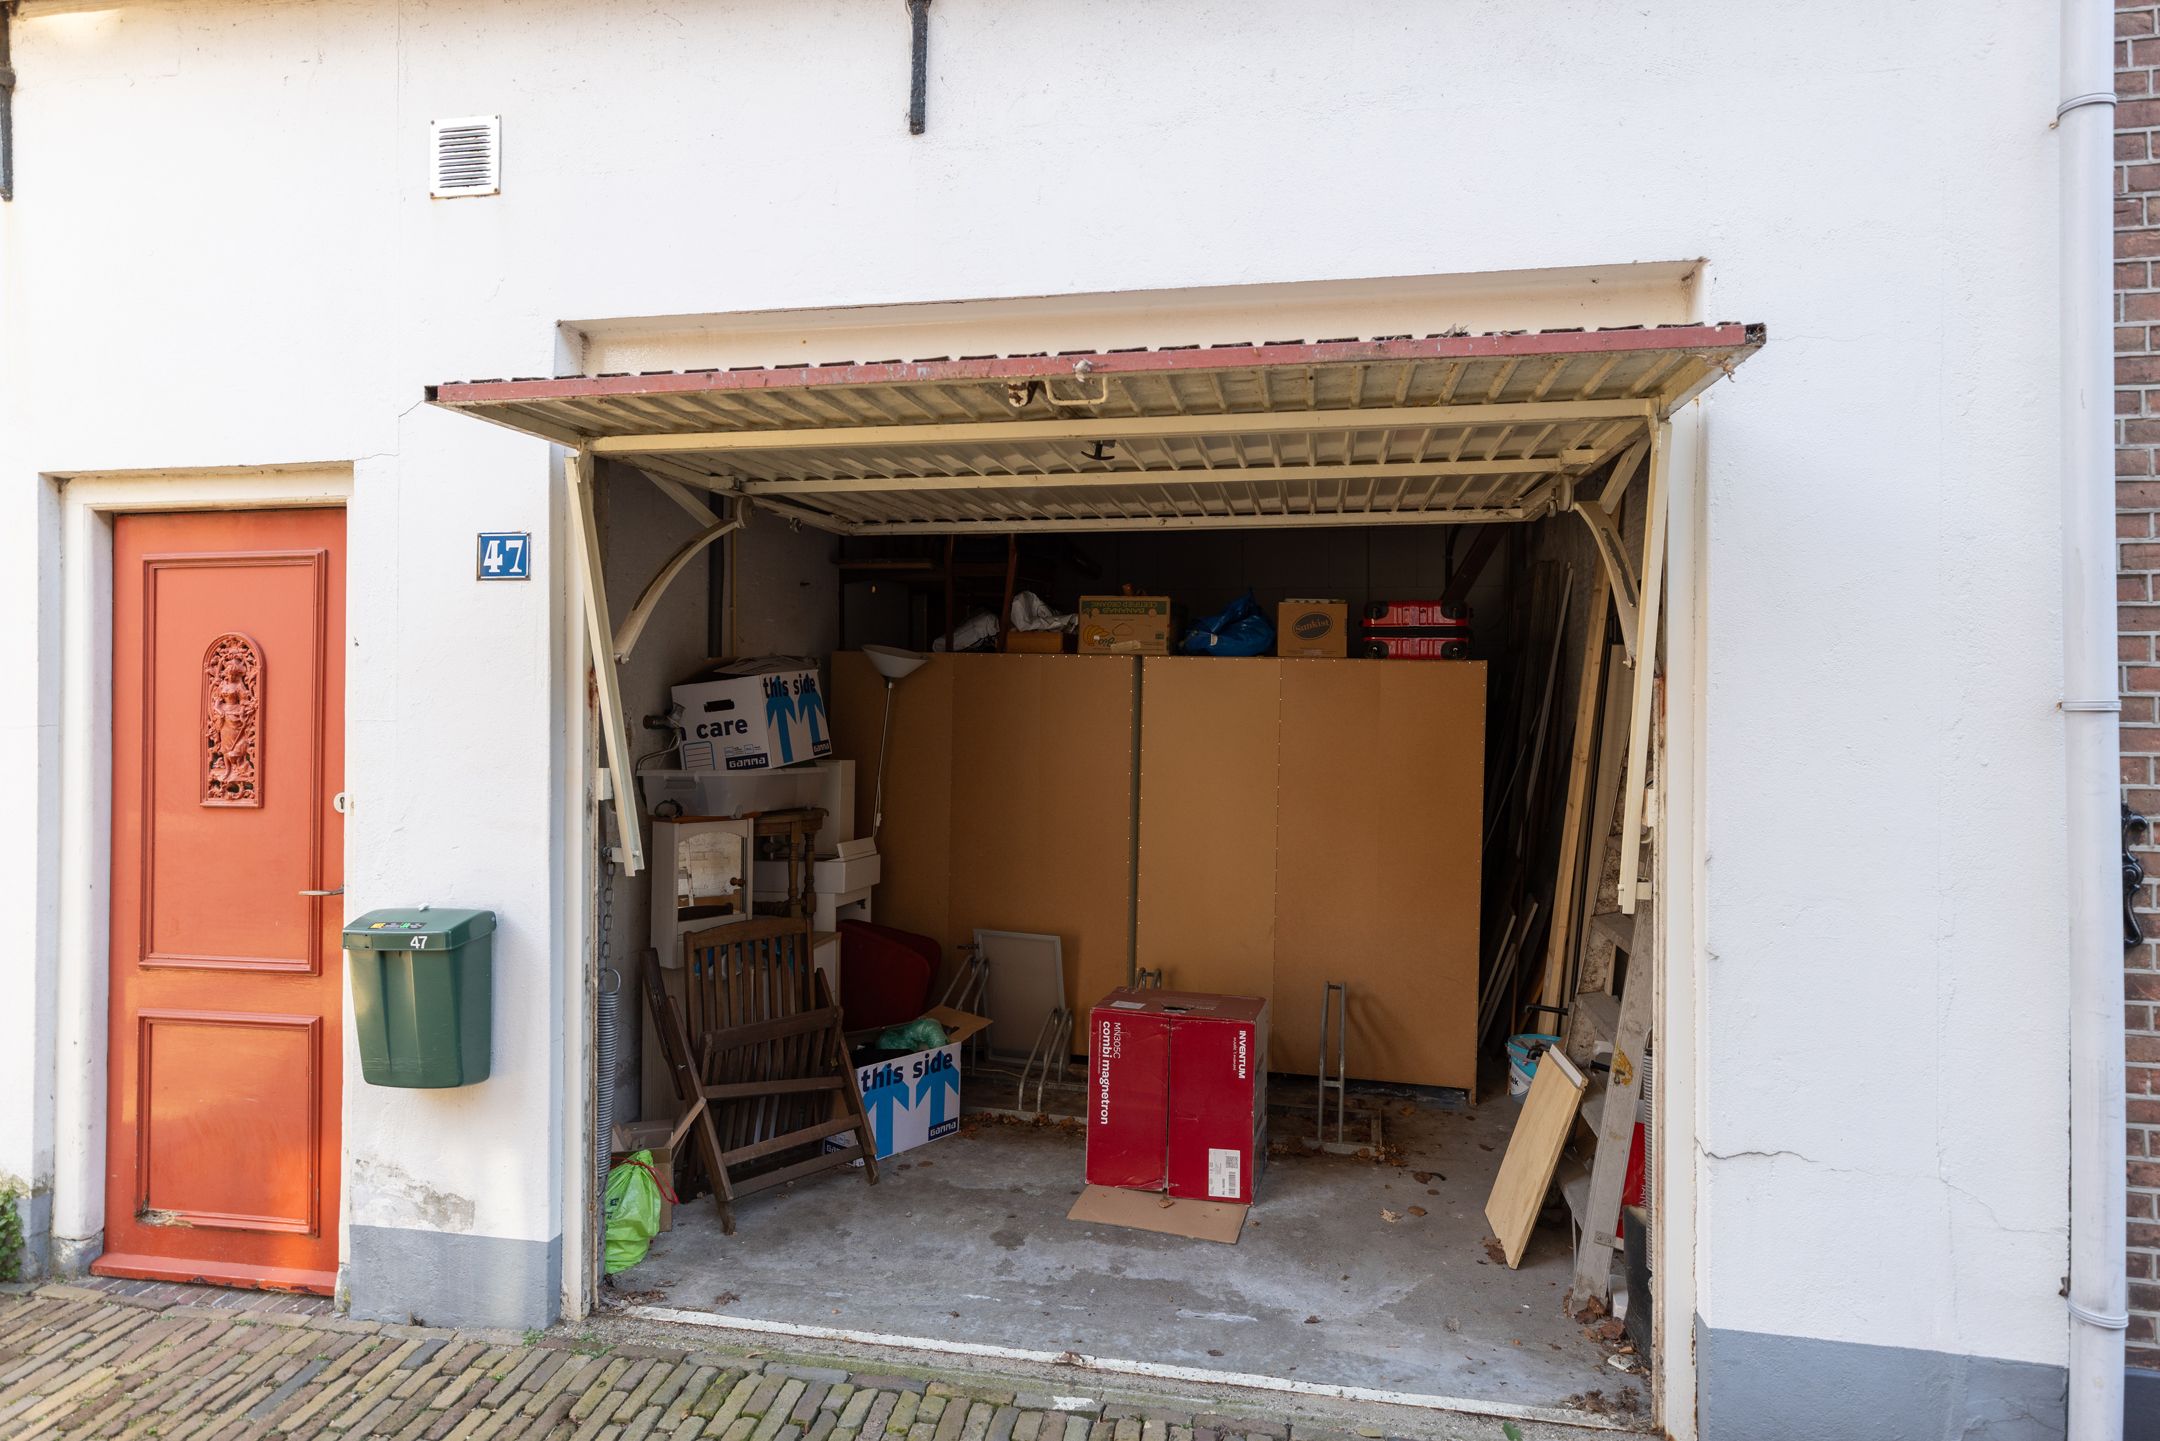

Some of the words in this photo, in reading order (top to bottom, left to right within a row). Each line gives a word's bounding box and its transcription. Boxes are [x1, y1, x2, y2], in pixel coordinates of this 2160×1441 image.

[483, 540, 523, 572] 47
[763, 675, 789, 698] this
[793, 673, 816, 695] side
[696, 718, 748, 739] care
[410, 935, 428, 949] 47
[1102, 1021, 1113, 1059] combi
[1113, 1022, 1121, 1059] MN305C
[1238, 1030, 1247, 1079] INVENTUM
[861, 1063, 904, 1093] this
[912, 1050, 953, 1078] side
[1099, 1058, 1110, 1125] magnetron
